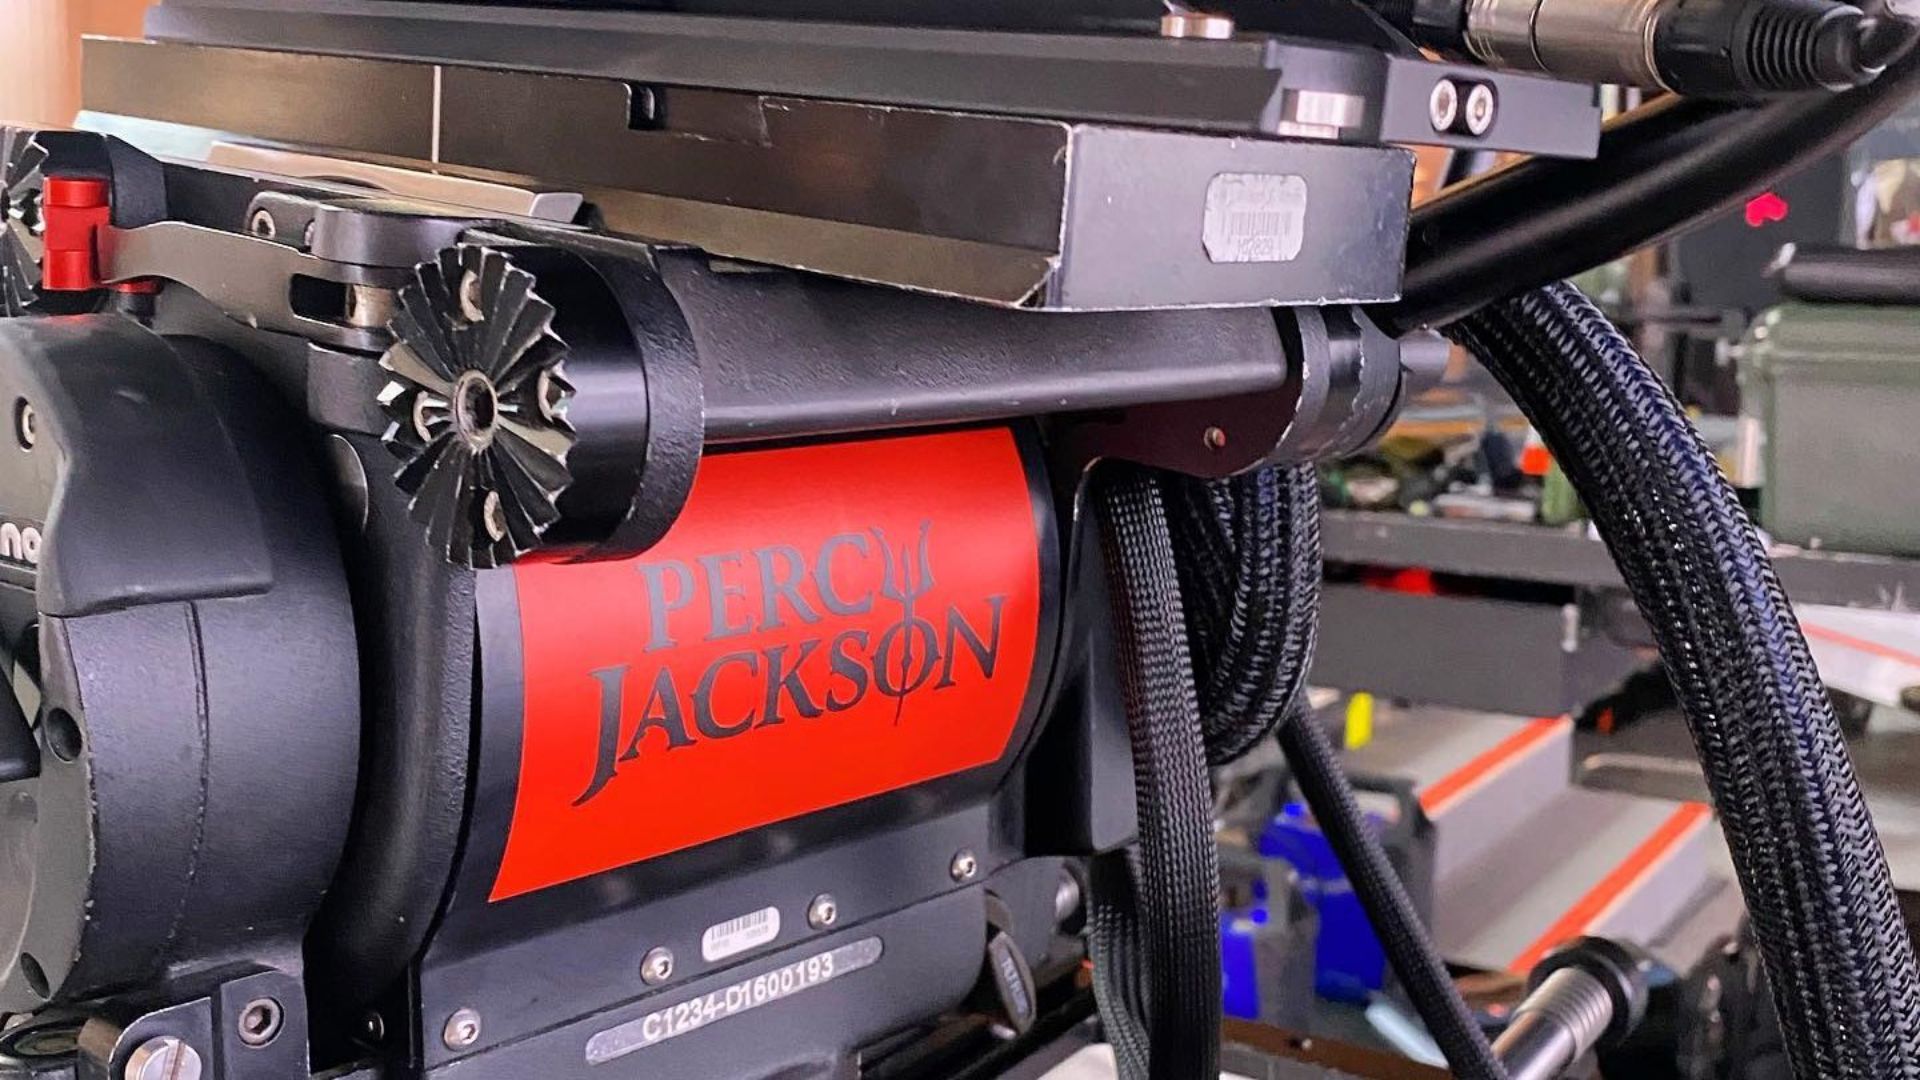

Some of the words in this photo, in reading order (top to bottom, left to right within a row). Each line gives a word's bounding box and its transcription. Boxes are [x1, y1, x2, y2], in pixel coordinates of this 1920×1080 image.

[572, 593, 1006, 806] JACKSON
[637, 519, 936, 725] PERCY
[642, 952, 834, 1041] C1234-D1600193
